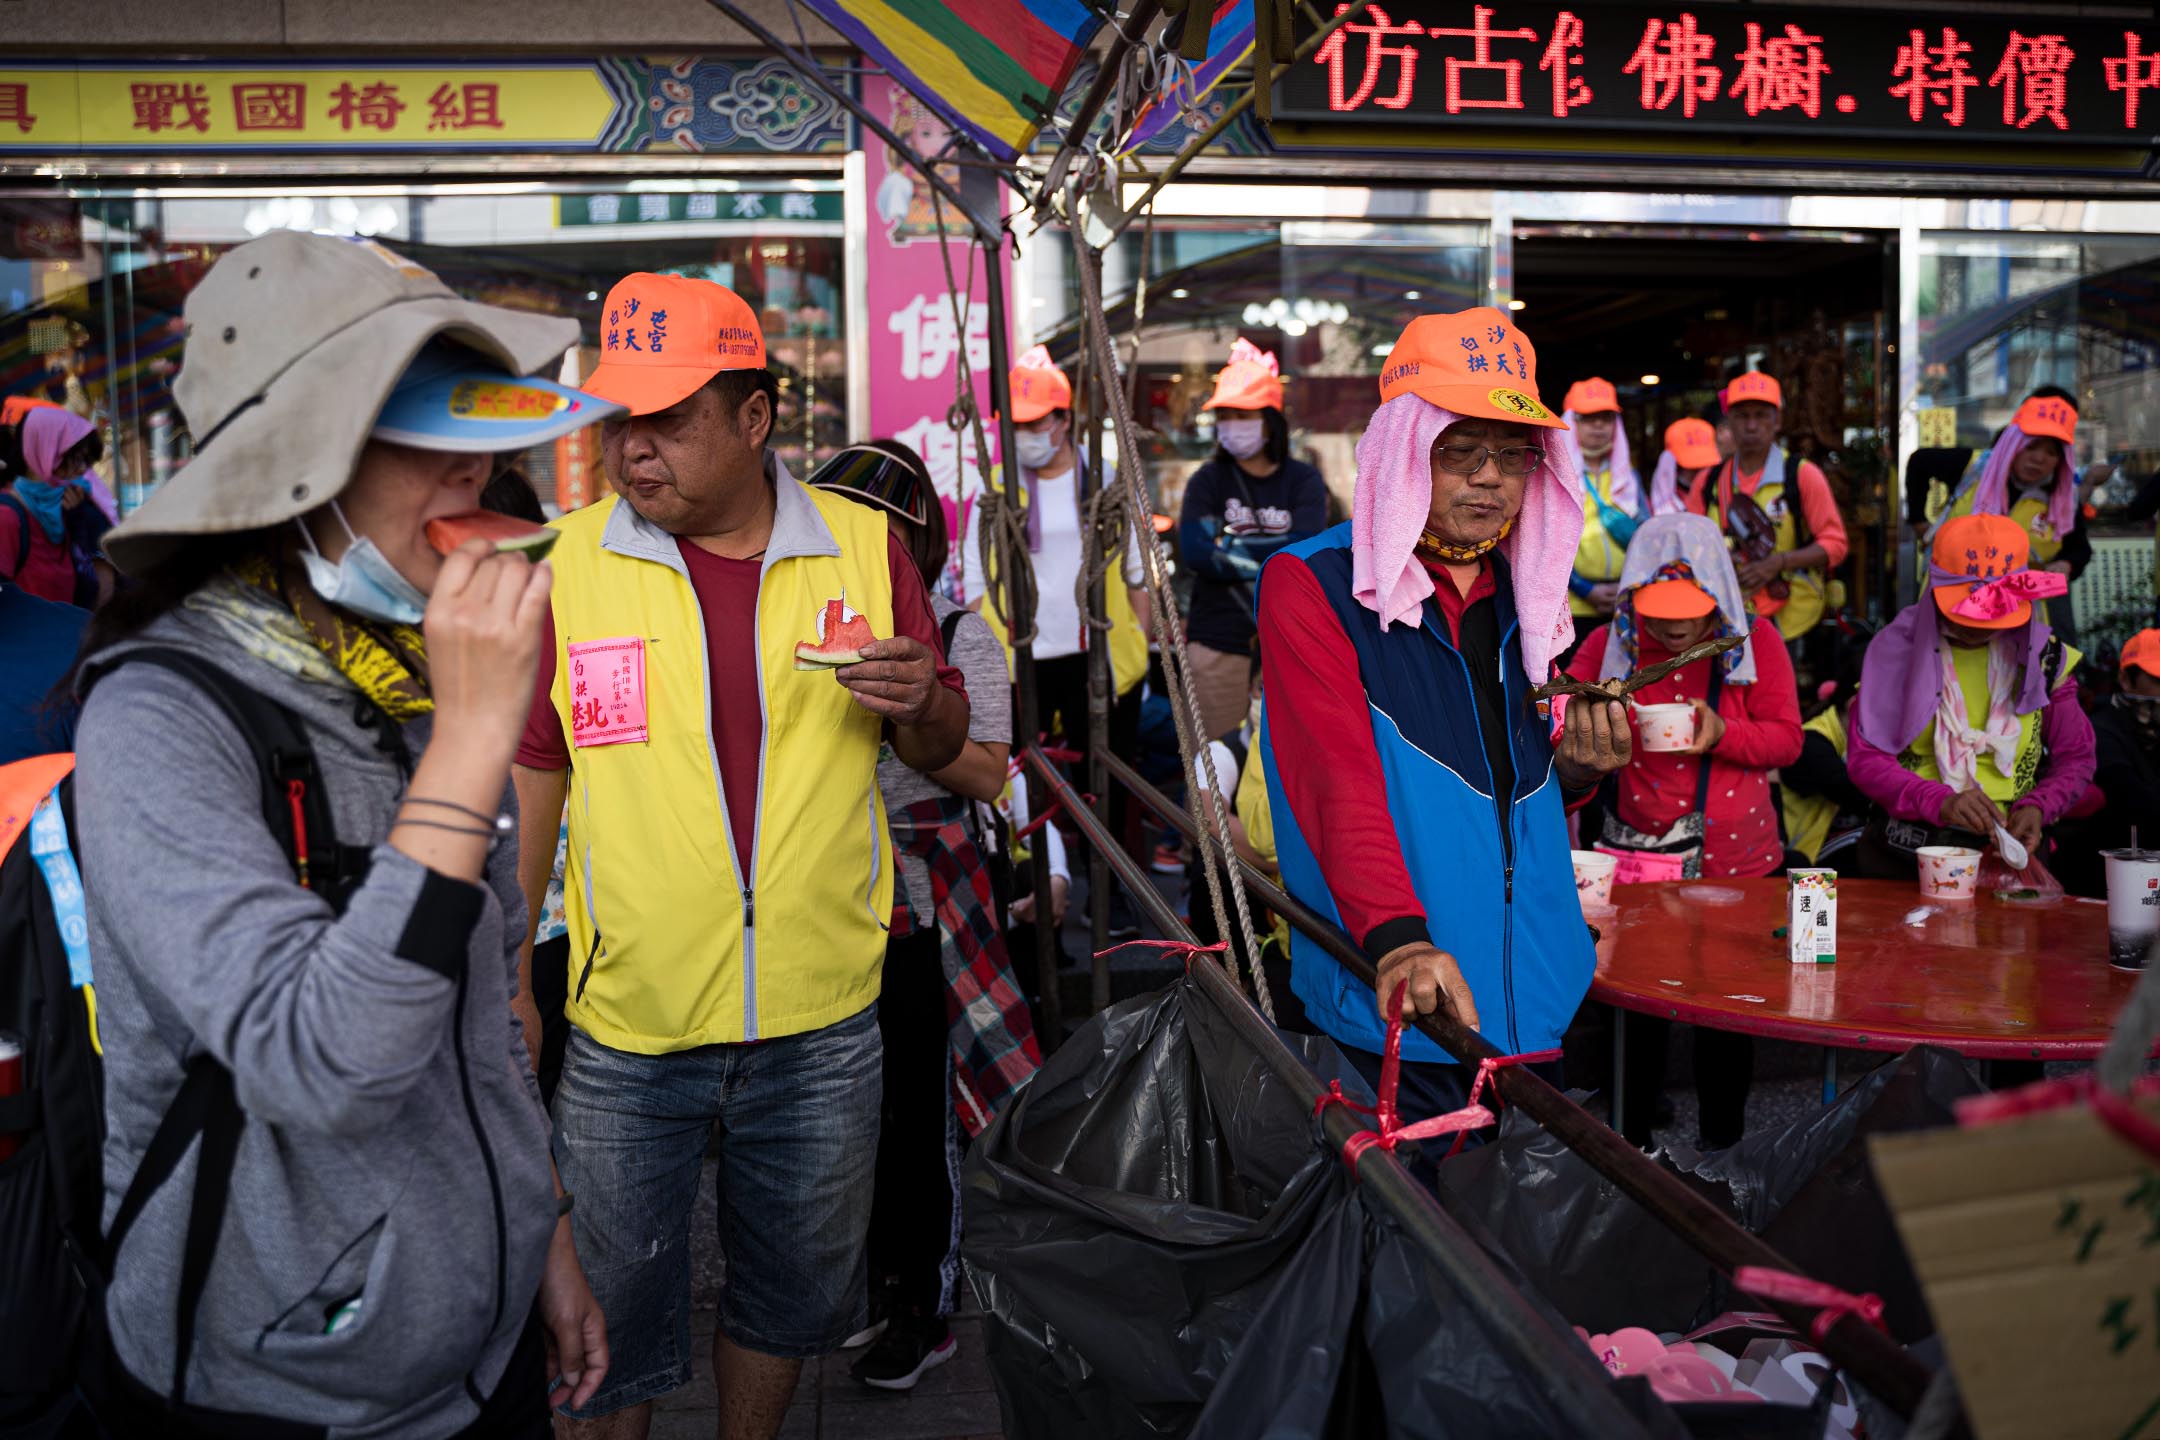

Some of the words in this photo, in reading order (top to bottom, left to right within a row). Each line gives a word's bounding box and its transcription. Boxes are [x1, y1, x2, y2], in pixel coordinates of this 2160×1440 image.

[130, 81, 505, 132] 戰國椅組
[610, 298, 667, 331] 白沙屯
[607, 328, 667, 353] 拱天宮
